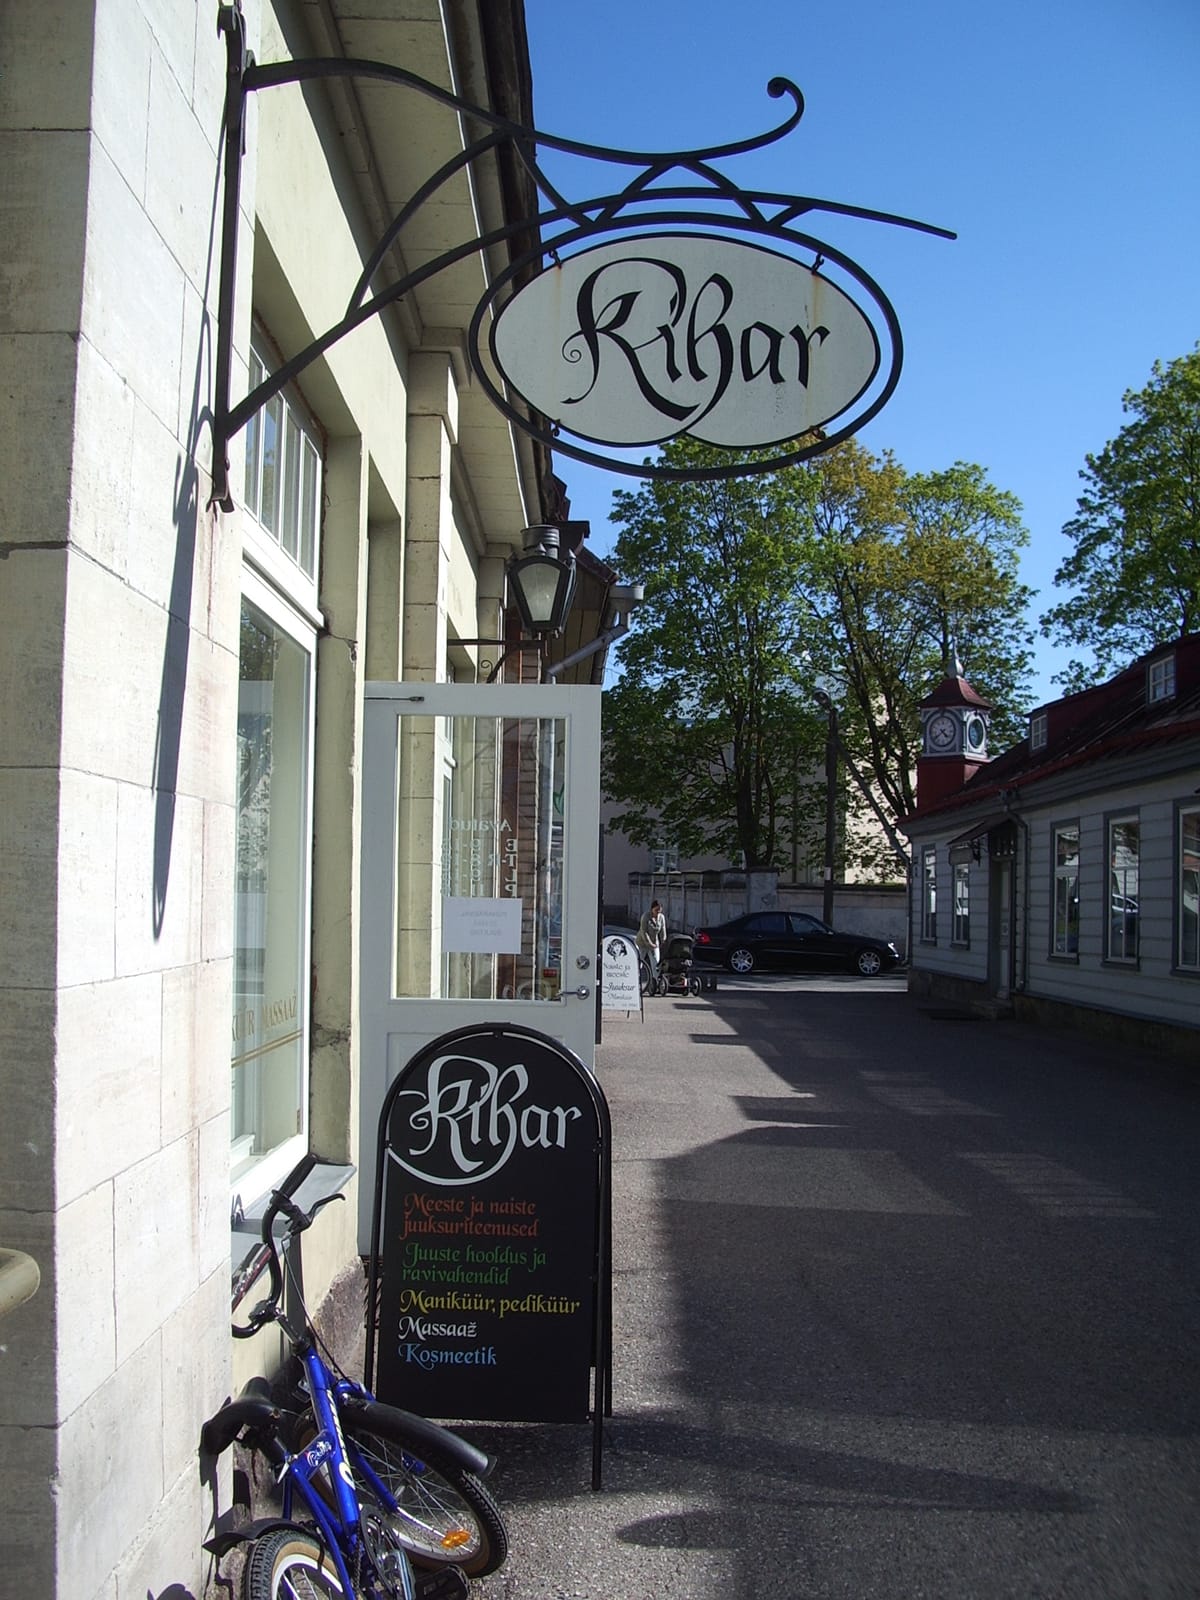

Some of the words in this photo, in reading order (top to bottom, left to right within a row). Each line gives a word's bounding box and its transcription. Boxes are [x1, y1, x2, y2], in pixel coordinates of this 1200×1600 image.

[561, 257, 831, 421] Kihar
[388, 1054, 583, 1186] Kihar
[404, 1193, 464, 1217] Meeste
[470, 1196, 484, 1217] ja
[489, 1197, 537, 1215] naiste
[399, 1213, 540, 1240] juuksuriteenused
[403, 1242, 461, 1268] Juuste
[466, 1245, 528, 1265] hooldus
[528, 1248, 546, 1272] ja
[402, 1265, 511, 1285] ravivahendid
[400, 1289, 496, 1314] Maniküür,
[498, 1294, 580, 1318] pediküür
[398, 1316, 478, 1341] Massaaž
[398, 1343, 497, 1371] Kosmeetik
